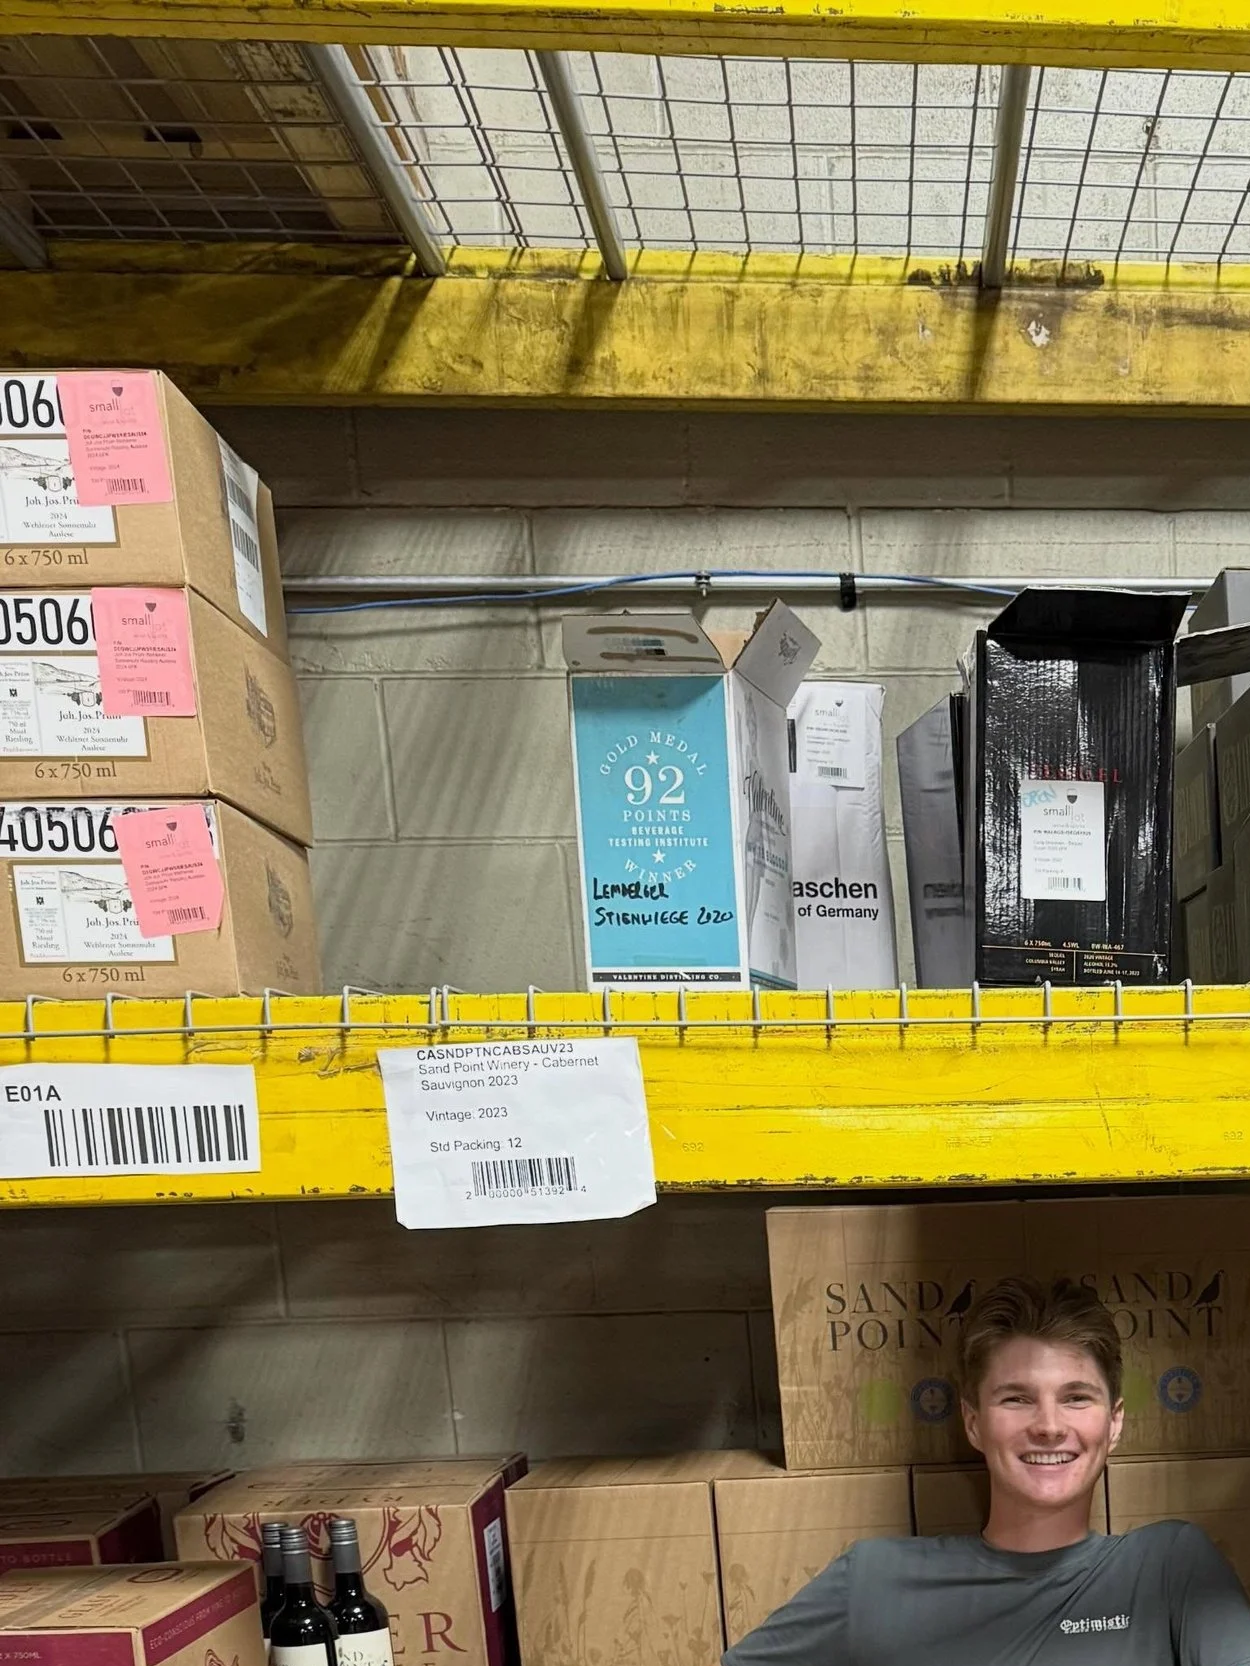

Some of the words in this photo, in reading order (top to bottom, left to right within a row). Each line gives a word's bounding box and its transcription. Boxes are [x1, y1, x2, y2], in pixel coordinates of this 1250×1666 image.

[4, 550, 15, 566] 6
[18, 554, 30, 566] x
[31, 550, 62, 566] 750
[68, 548, 89, 565] ml
[121, 614, 151, 626] small
[599, 735, 639, 776] GOLD
[649, 730, 708, 776] MEDAL
[624, 765, 685, 805] 92
[623, 809, 691, 823] POINTS
[1043, 805, 1071, 816] small
[631, 826, 684, 835] BEVERAGE
[145, 834, 175, 849] small
[608, 838, 651, 847] TESTING
[655, 838, 708, 847] INSTITUTE
[624, 858, 697, 884] WINNER
[792, 876, 878, 899] aschen
[797, 905, 811, 917] of
[813, 905, 879, 921] Germany
[62, 967, 72, 982] 6
[77, 971, 87, 982] x
[89, 967, 119, 982] 750
[124, 966, 145, 982] ml
[417, 1043, 574, 1061] CASNDPTNCABSAUV23
[419, 1063, 450, 1075] Sand
[454, 1062, 485, 1074] Point
[487, 1059, 530, 1072] Winery
[542, 1056, 599, 1068] Cabernet
[421, 1078, 485, 1092] Sauvignon
[488, 1075, 518, 1087] 2023
[5, 1084, 61, 1102] E01A
[478, 1107, 508, 1119] 2023
[430, 1141, 450, 1152] Std
[508, 1138, 522, 1148] 12
[530, 1186, 565, 1196] 51392
[826, 1280, 944, 1316] SAND
[1111, 1306, 1223, 1343] OINT
